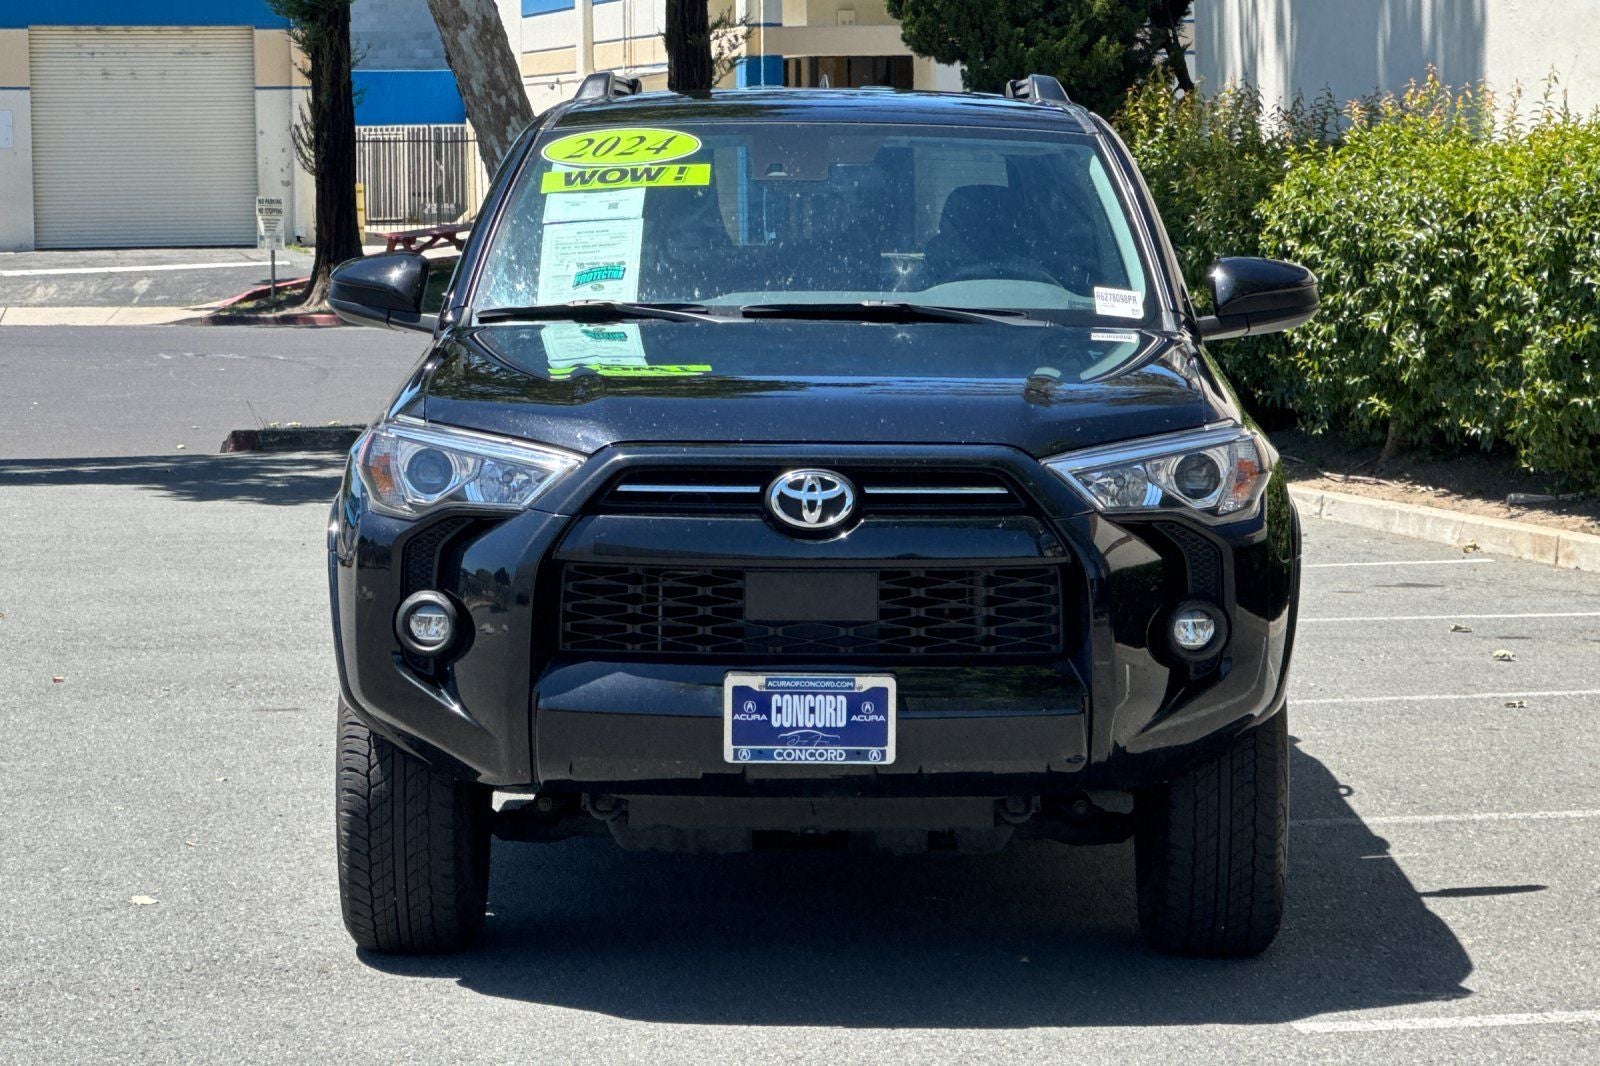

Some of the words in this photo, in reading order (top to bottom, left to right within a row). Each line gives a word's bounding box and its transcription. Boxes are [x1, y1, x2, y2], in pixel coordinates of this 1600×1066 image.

[563, 134, 679, 160] 2024
[767, 680, 854, 688] ACURAOFCONCORD.COM
[771, 694, 847, 728] CONCORD
[733, 713, 768, 721] ACURA
[851, 714, 886, 722] ACURA
[773, 749, 846, 761] CONCORD
